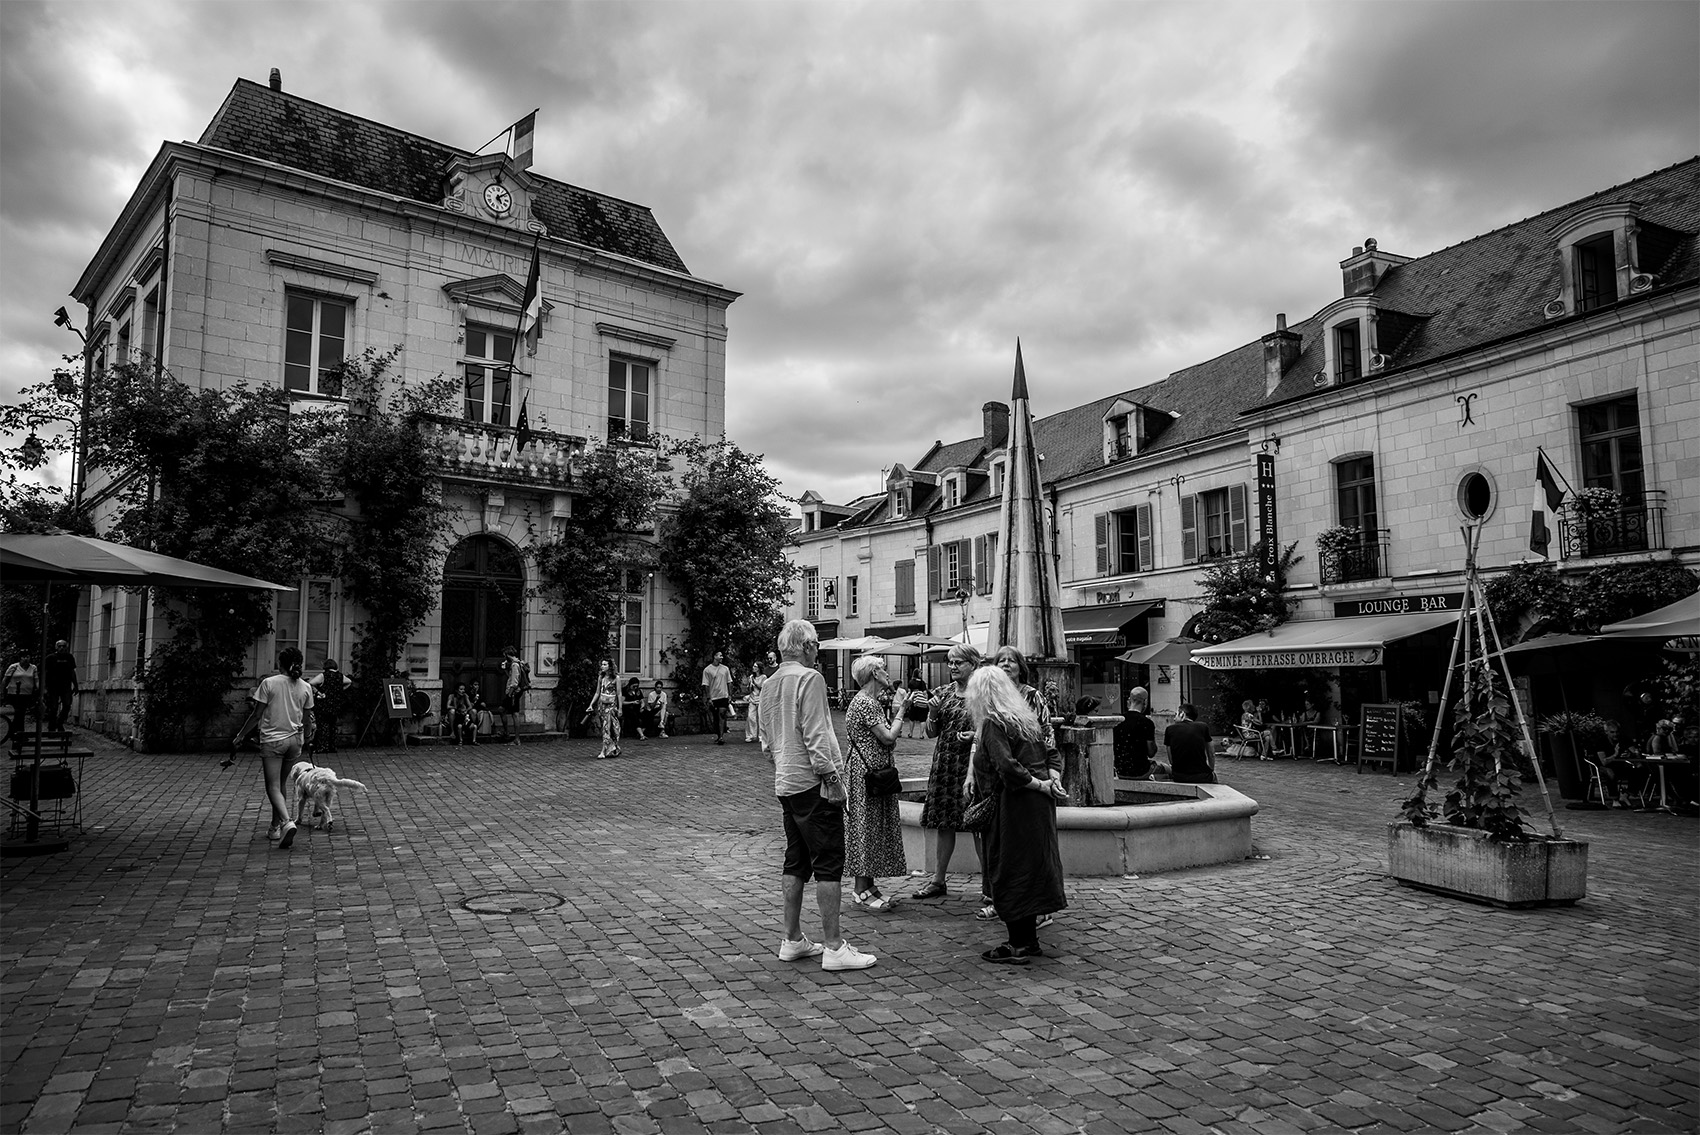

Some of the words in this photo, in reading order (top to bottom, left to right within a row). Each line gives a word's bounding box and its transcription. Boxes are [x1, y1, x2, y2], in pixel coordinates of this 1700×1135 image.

[1262, 462, 1272, 477] H
[1265, 494, 1274, 535] Blanche
[1267, 537, 1275, 565] Croix
[1358, 599, 1410, 614] LOUNGE
[1420, 596, 1447, 609] BAR
[1200, 653, 1243, 667] CHEMINÉE
[1250, 653, 1296, 666] TERRASSE
[1300, 650, 1355, 665] OMBRAGÉE
